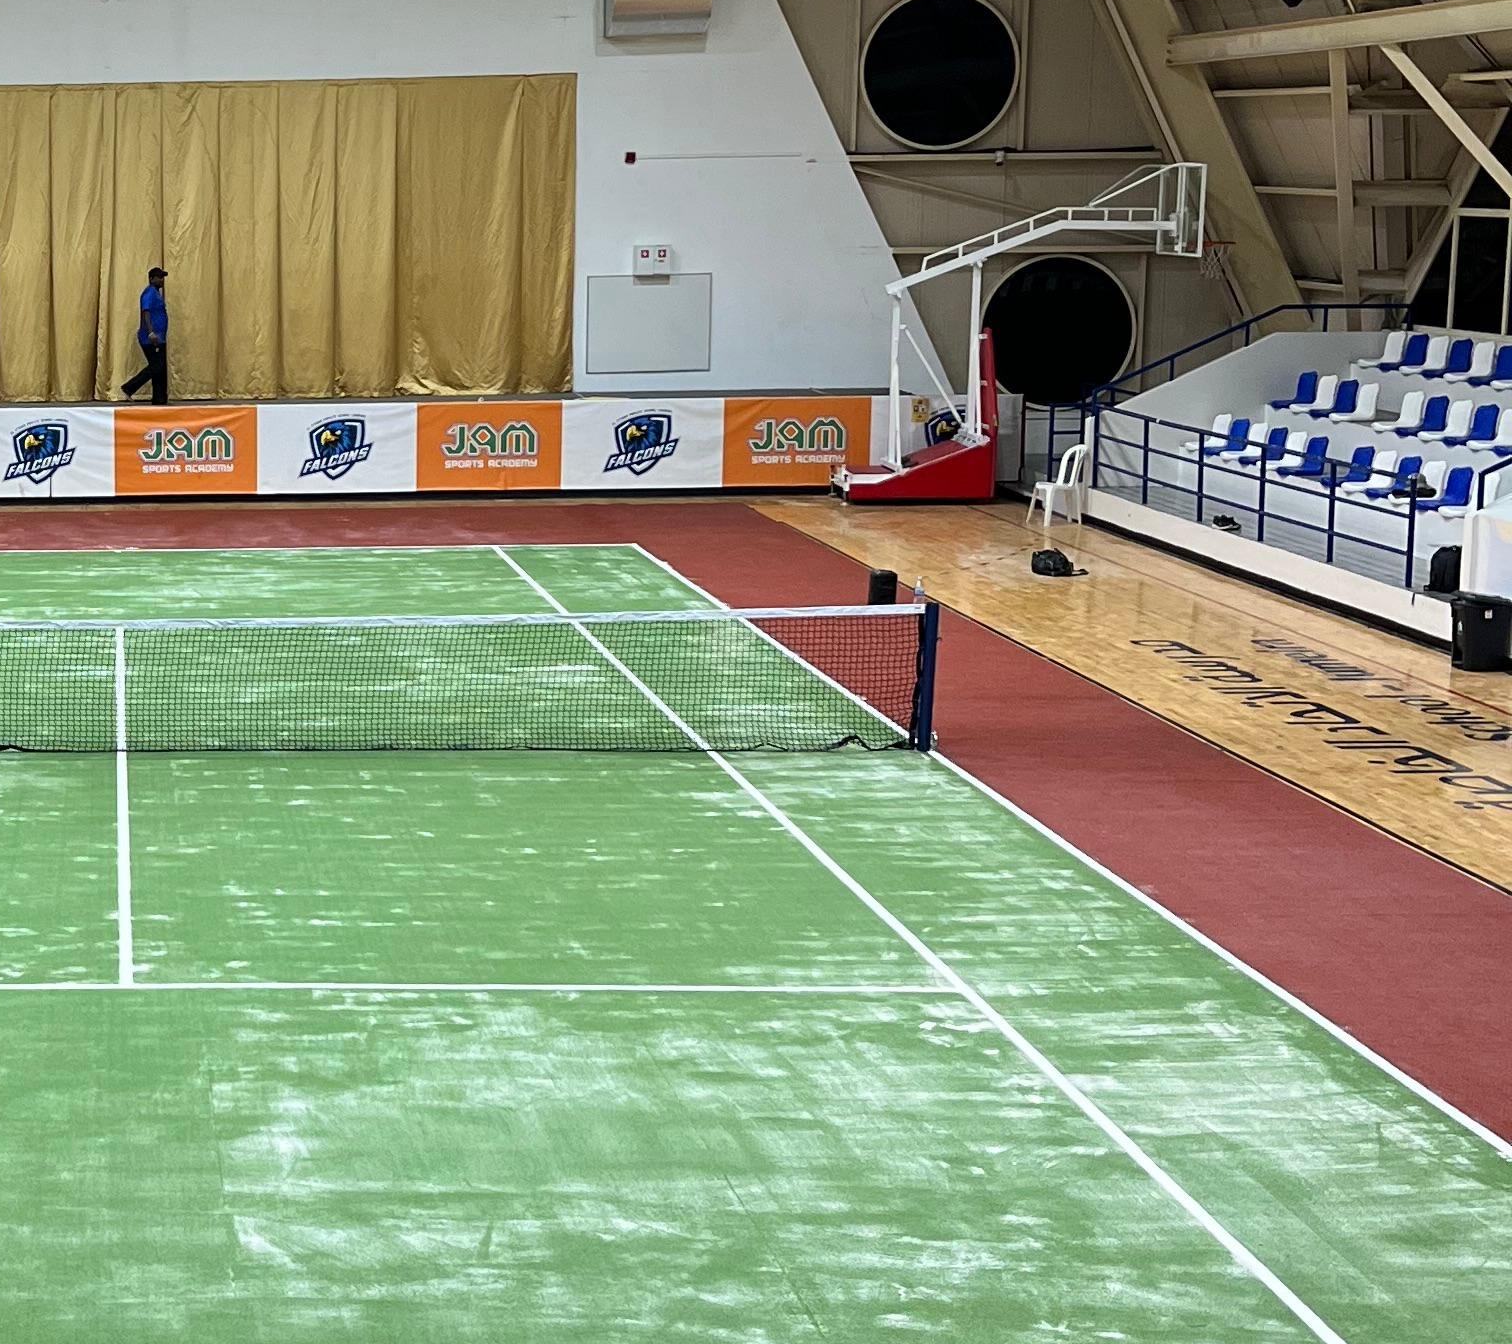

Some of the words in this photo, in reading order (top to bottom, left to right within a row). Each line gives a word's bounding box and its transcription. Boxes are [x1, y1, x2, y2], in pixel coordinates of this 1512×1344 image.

[137, 425, 235, 461] JAM
[440, 421, 539, 456] JAM
[748, 416, 846, 452] JAM
[6, 451, 73, 479] FALCONS
[142, 464, 181, 474] SPORTS
[185, 464, 234, 473] ACADEMY
[302, 447, 369, 474] FALCONS
[444, 459, 484, 469] SPORTS
[488, 459, 538, 468] ACADEMY
[607, 442, 676, 470] FALCONS
[752, 455, 791, 464] SPORTS
[795, 455, 845, 464] ACADEMY
